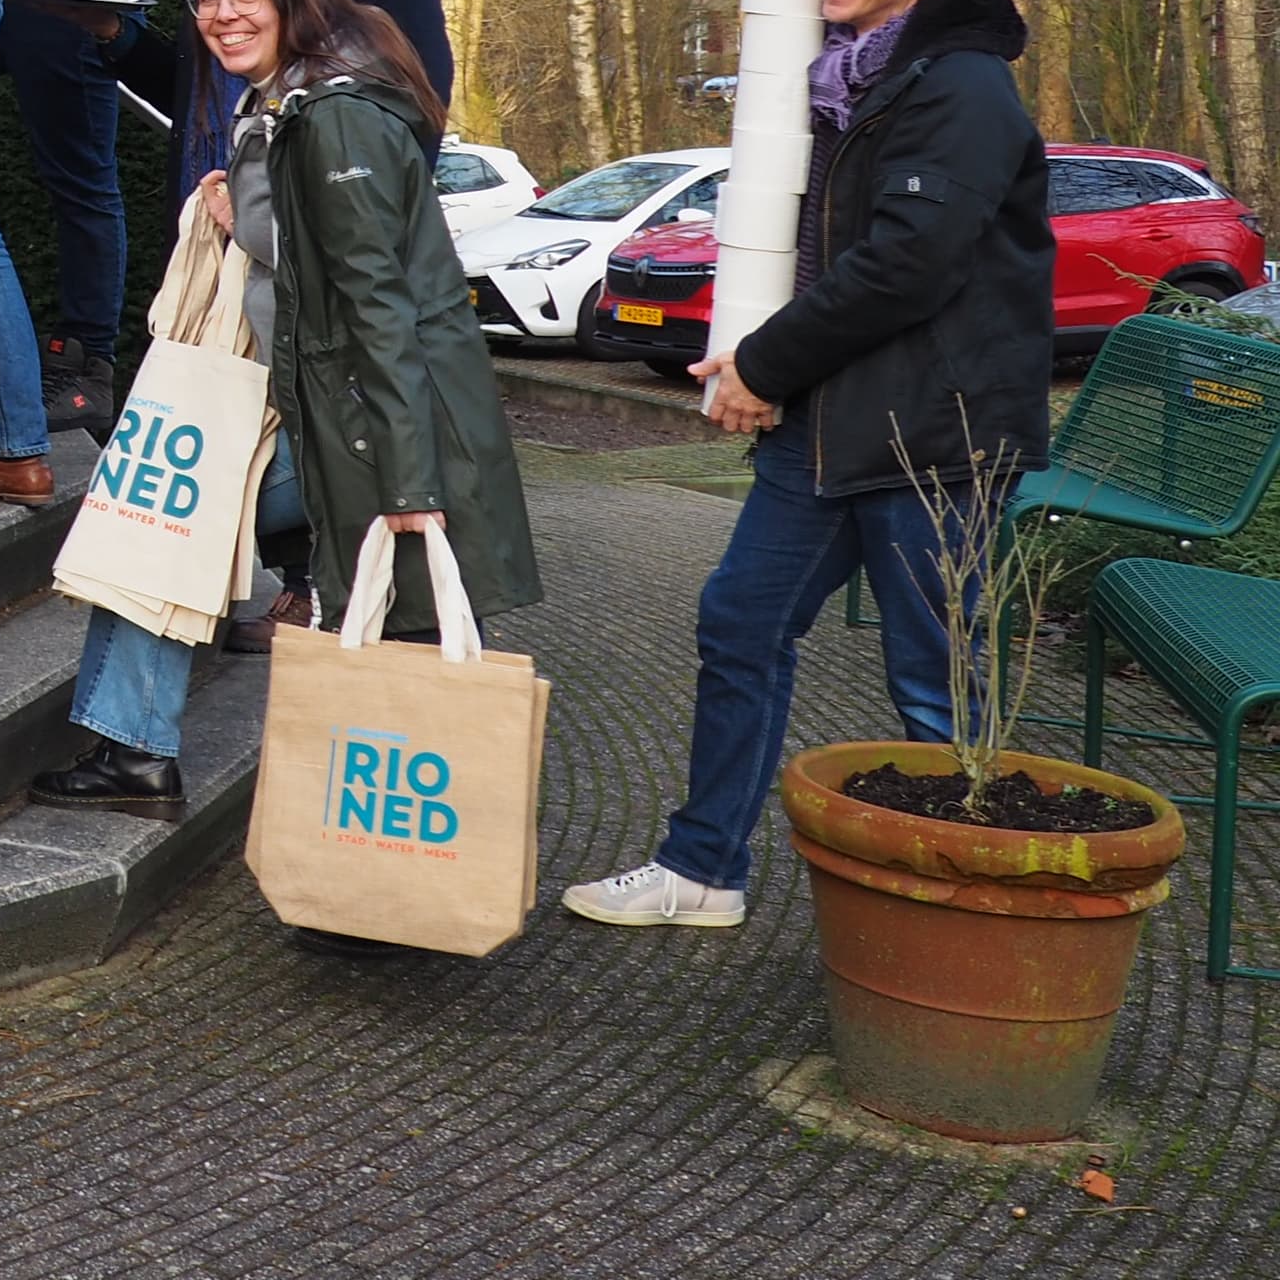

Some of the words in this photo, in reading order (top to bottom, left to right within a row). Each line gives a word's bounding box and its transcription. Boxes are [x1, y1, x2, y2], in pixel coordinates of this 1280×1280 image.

[108, 408, 204, 471] RIO
[90, 453, 200, 519] NED
[118, 507, 157, 525] WATER
[164, 522, 192, 537] MENS
[344, 741, 450, 798] RIO
[339, 787, 459, 844] NED
[336, 833, 367, 846] STAD
[376, 839, 416, 854] WATER
[424, 847, 458, 861] MENS
